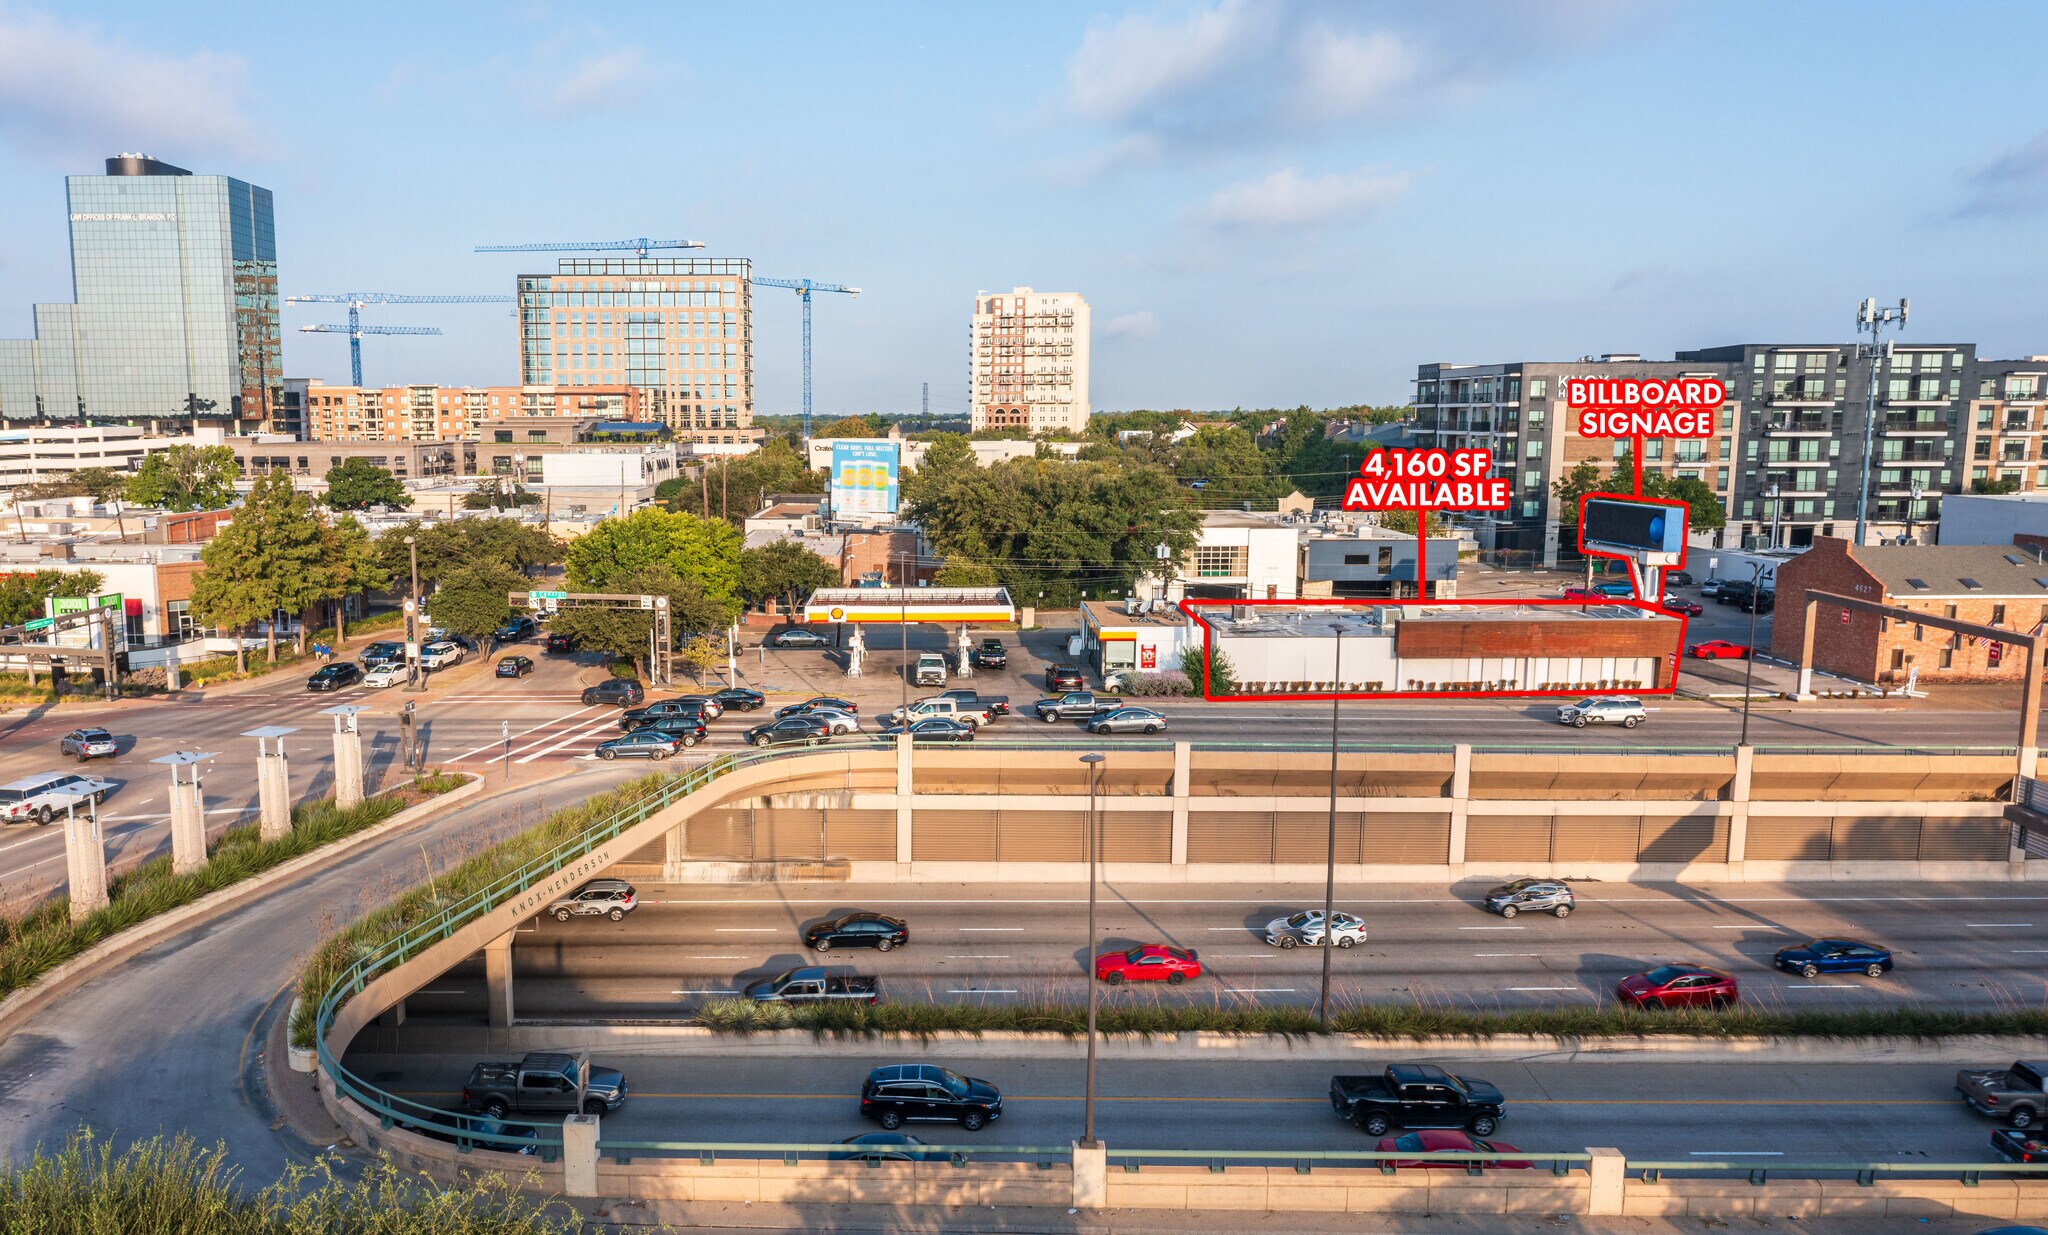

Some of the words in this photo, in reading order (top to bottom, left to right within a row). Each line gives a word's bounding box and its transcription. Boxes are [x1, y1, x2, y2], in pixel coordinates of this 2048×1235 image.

[70, 213, 81, 221] LAW
[82, 213, 105, 221] OFFICES
[105, 213, 114, 221] OF
[114, 213, 132, 221] FRANK
[1855, 584, 1872, 593] 4627
[60, 599, 82, 609] 3001
[510, 851, 610, 917] KNOX-HENDERSON
